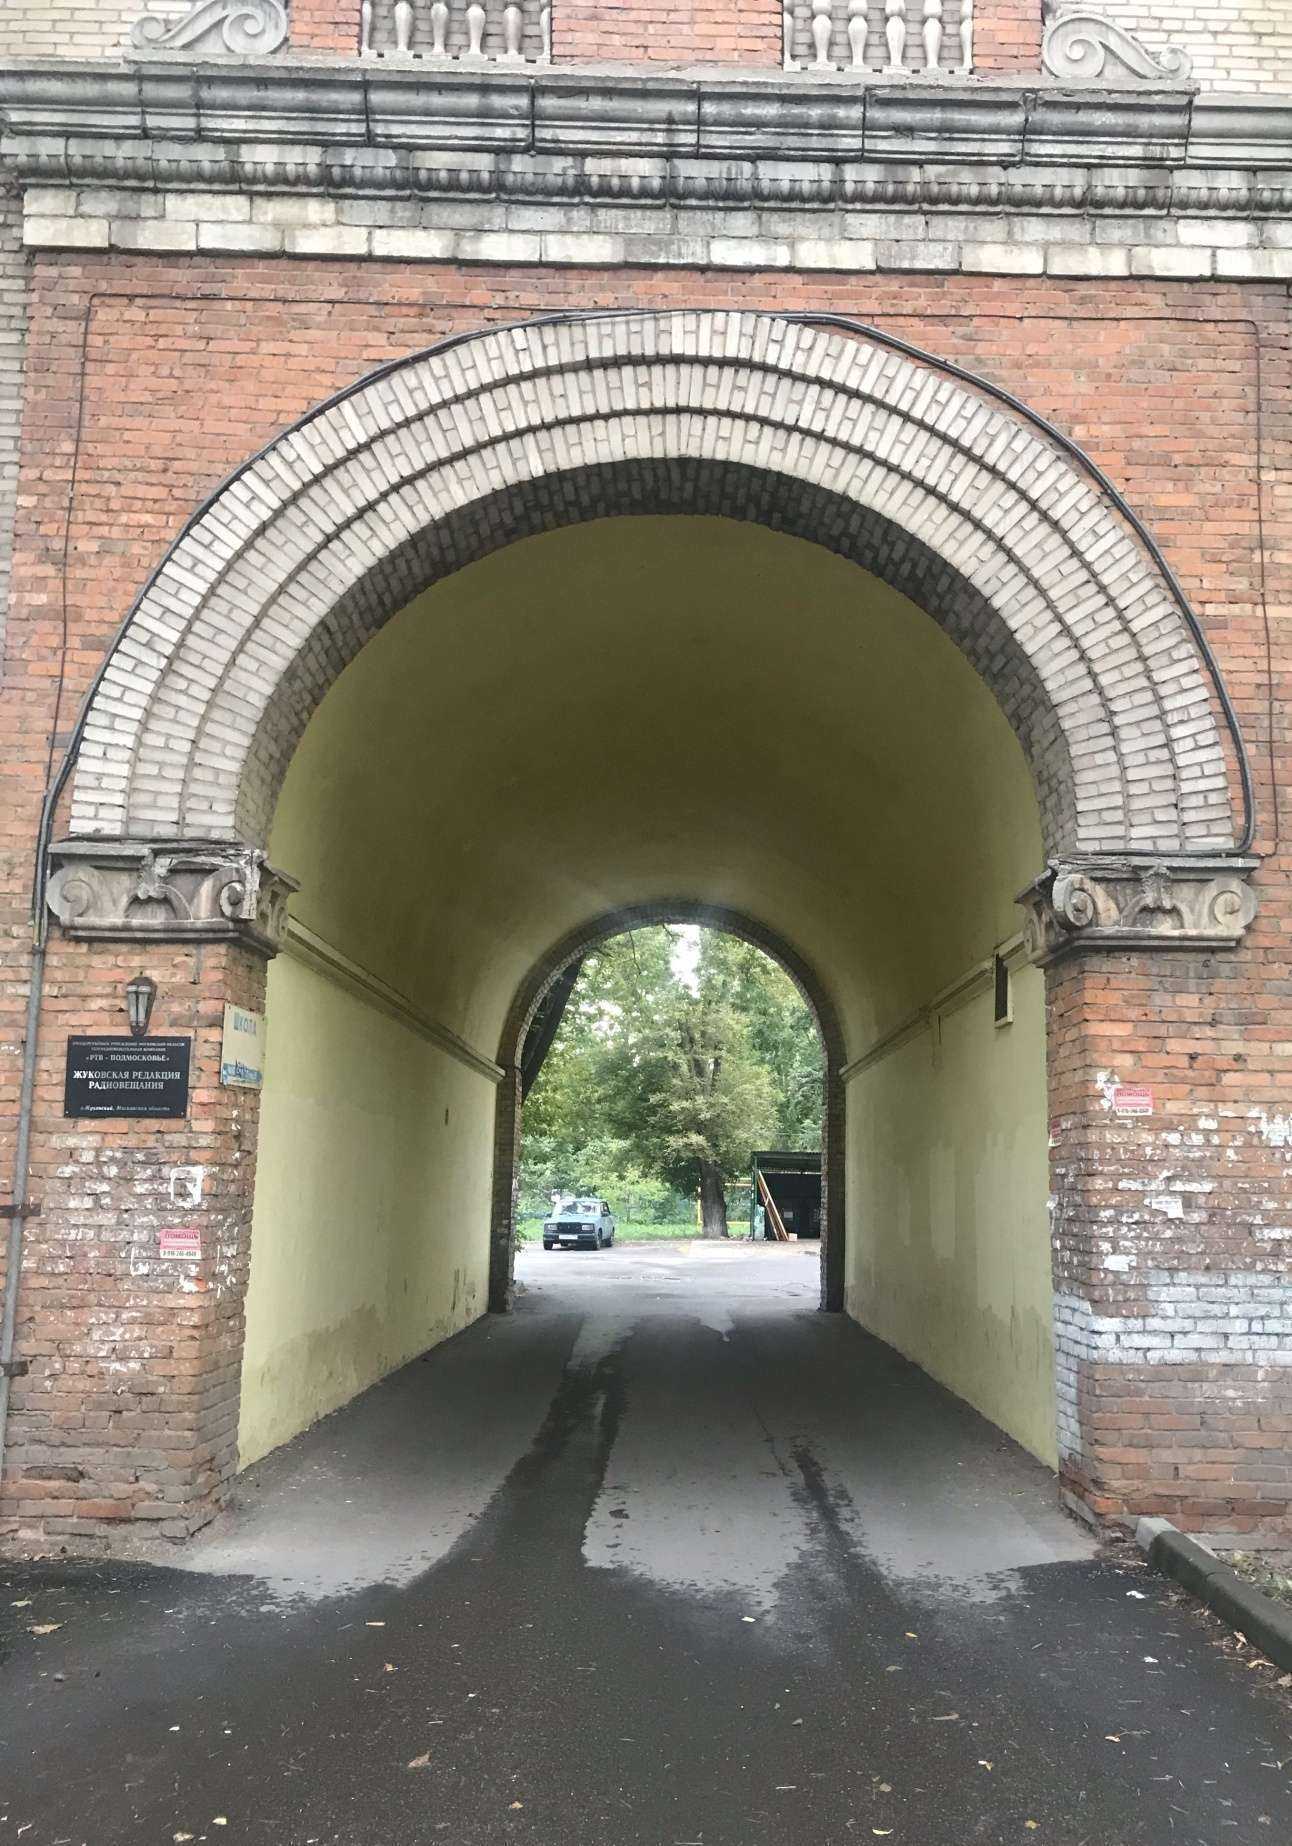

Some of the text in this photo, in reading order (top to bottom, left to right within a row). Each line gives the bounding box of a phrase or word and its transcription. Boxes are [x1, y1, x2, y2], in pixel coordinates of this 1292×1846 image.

[73, 1070, 181, 1080] ЖУКОВСКАЯ РЕДАКЦИЯ
[88, 1081, 164, 1090] РАДИОВЕЩАНИЯ
